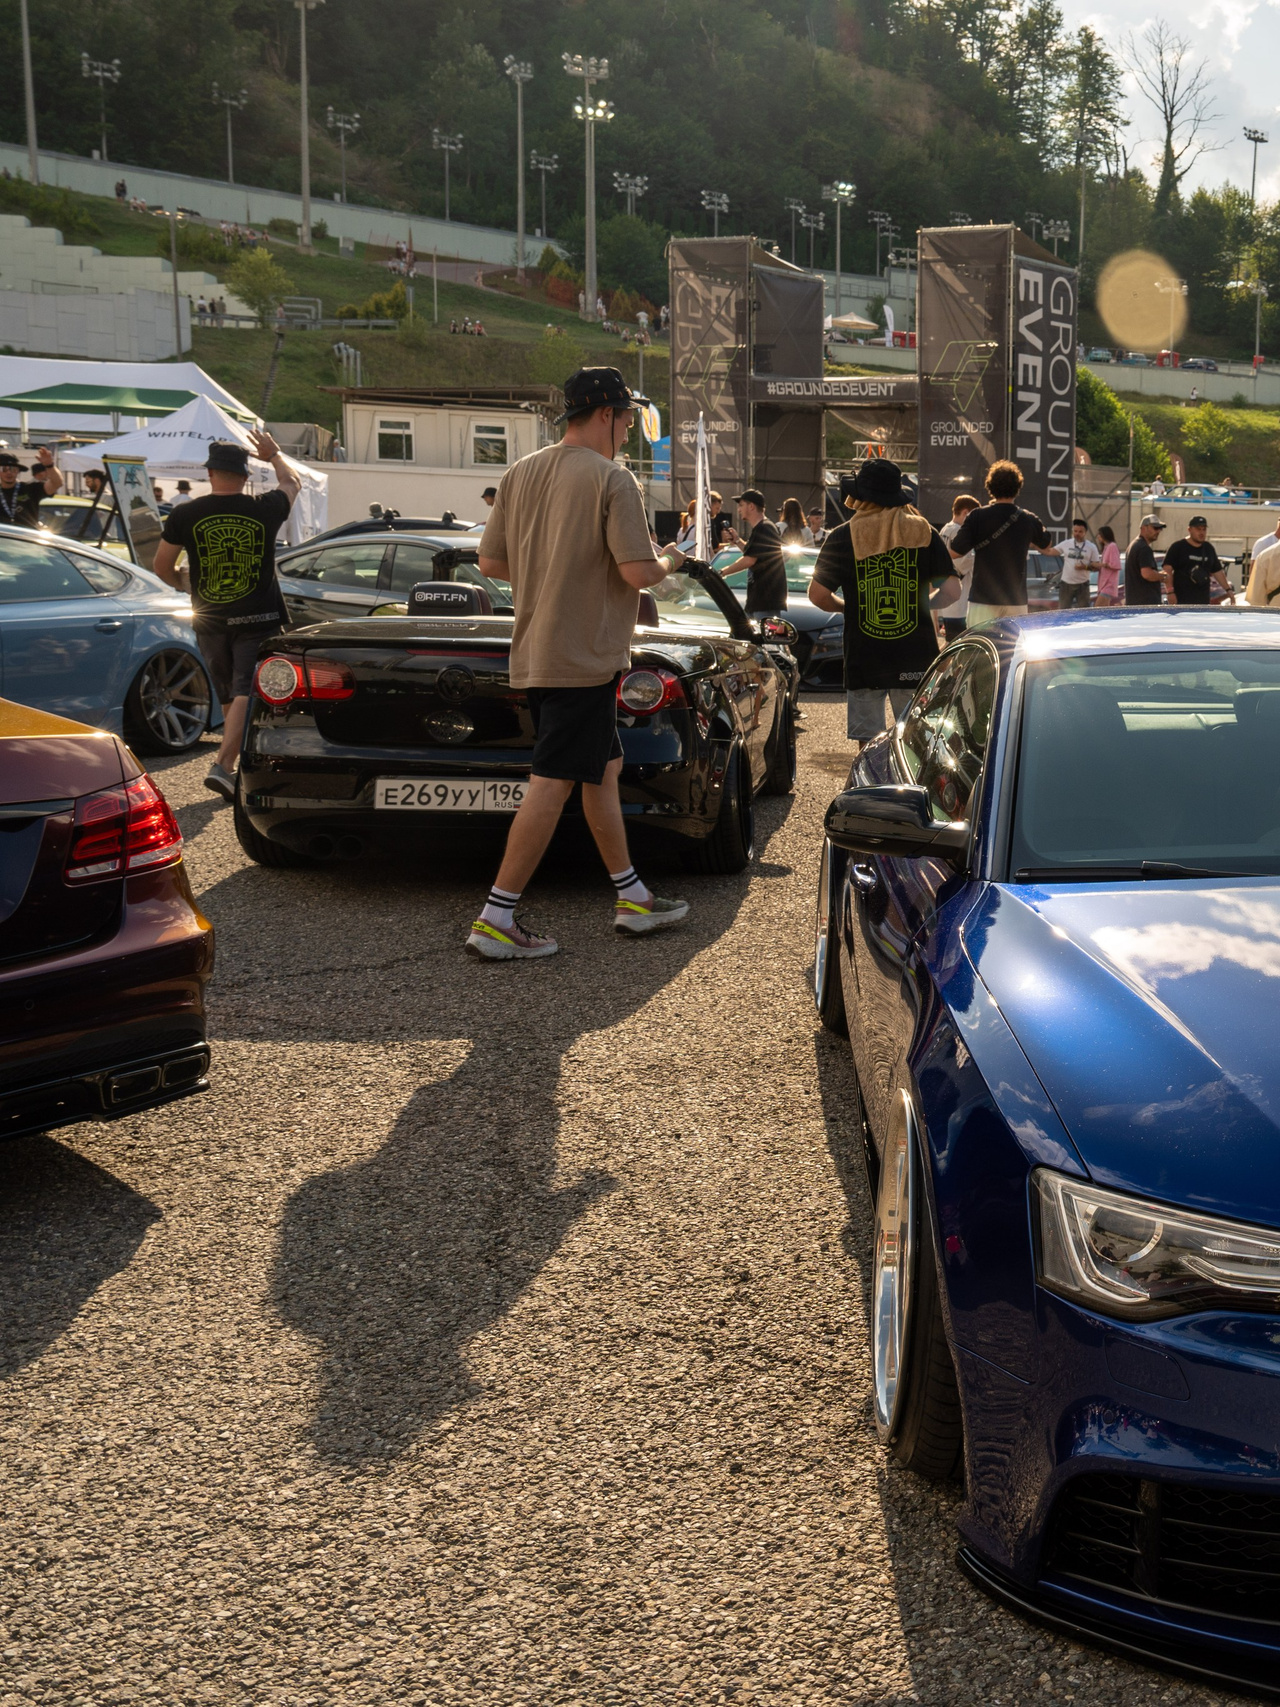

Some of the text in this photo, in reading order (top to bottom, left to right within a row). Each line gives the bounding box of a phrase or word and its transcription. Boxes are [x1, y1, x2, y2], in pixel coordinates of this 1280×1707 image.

[1016, 268, 1044, 473] EVENT
[767, 381, 897, 397] #GROUNDEDEVENT
[930, 421, 994, 433] GROUNDED
[930, 435, 969, 446] EVENT
[880, 561, 893, 569] HC
[861, 621, 883, 635] TWELVE
